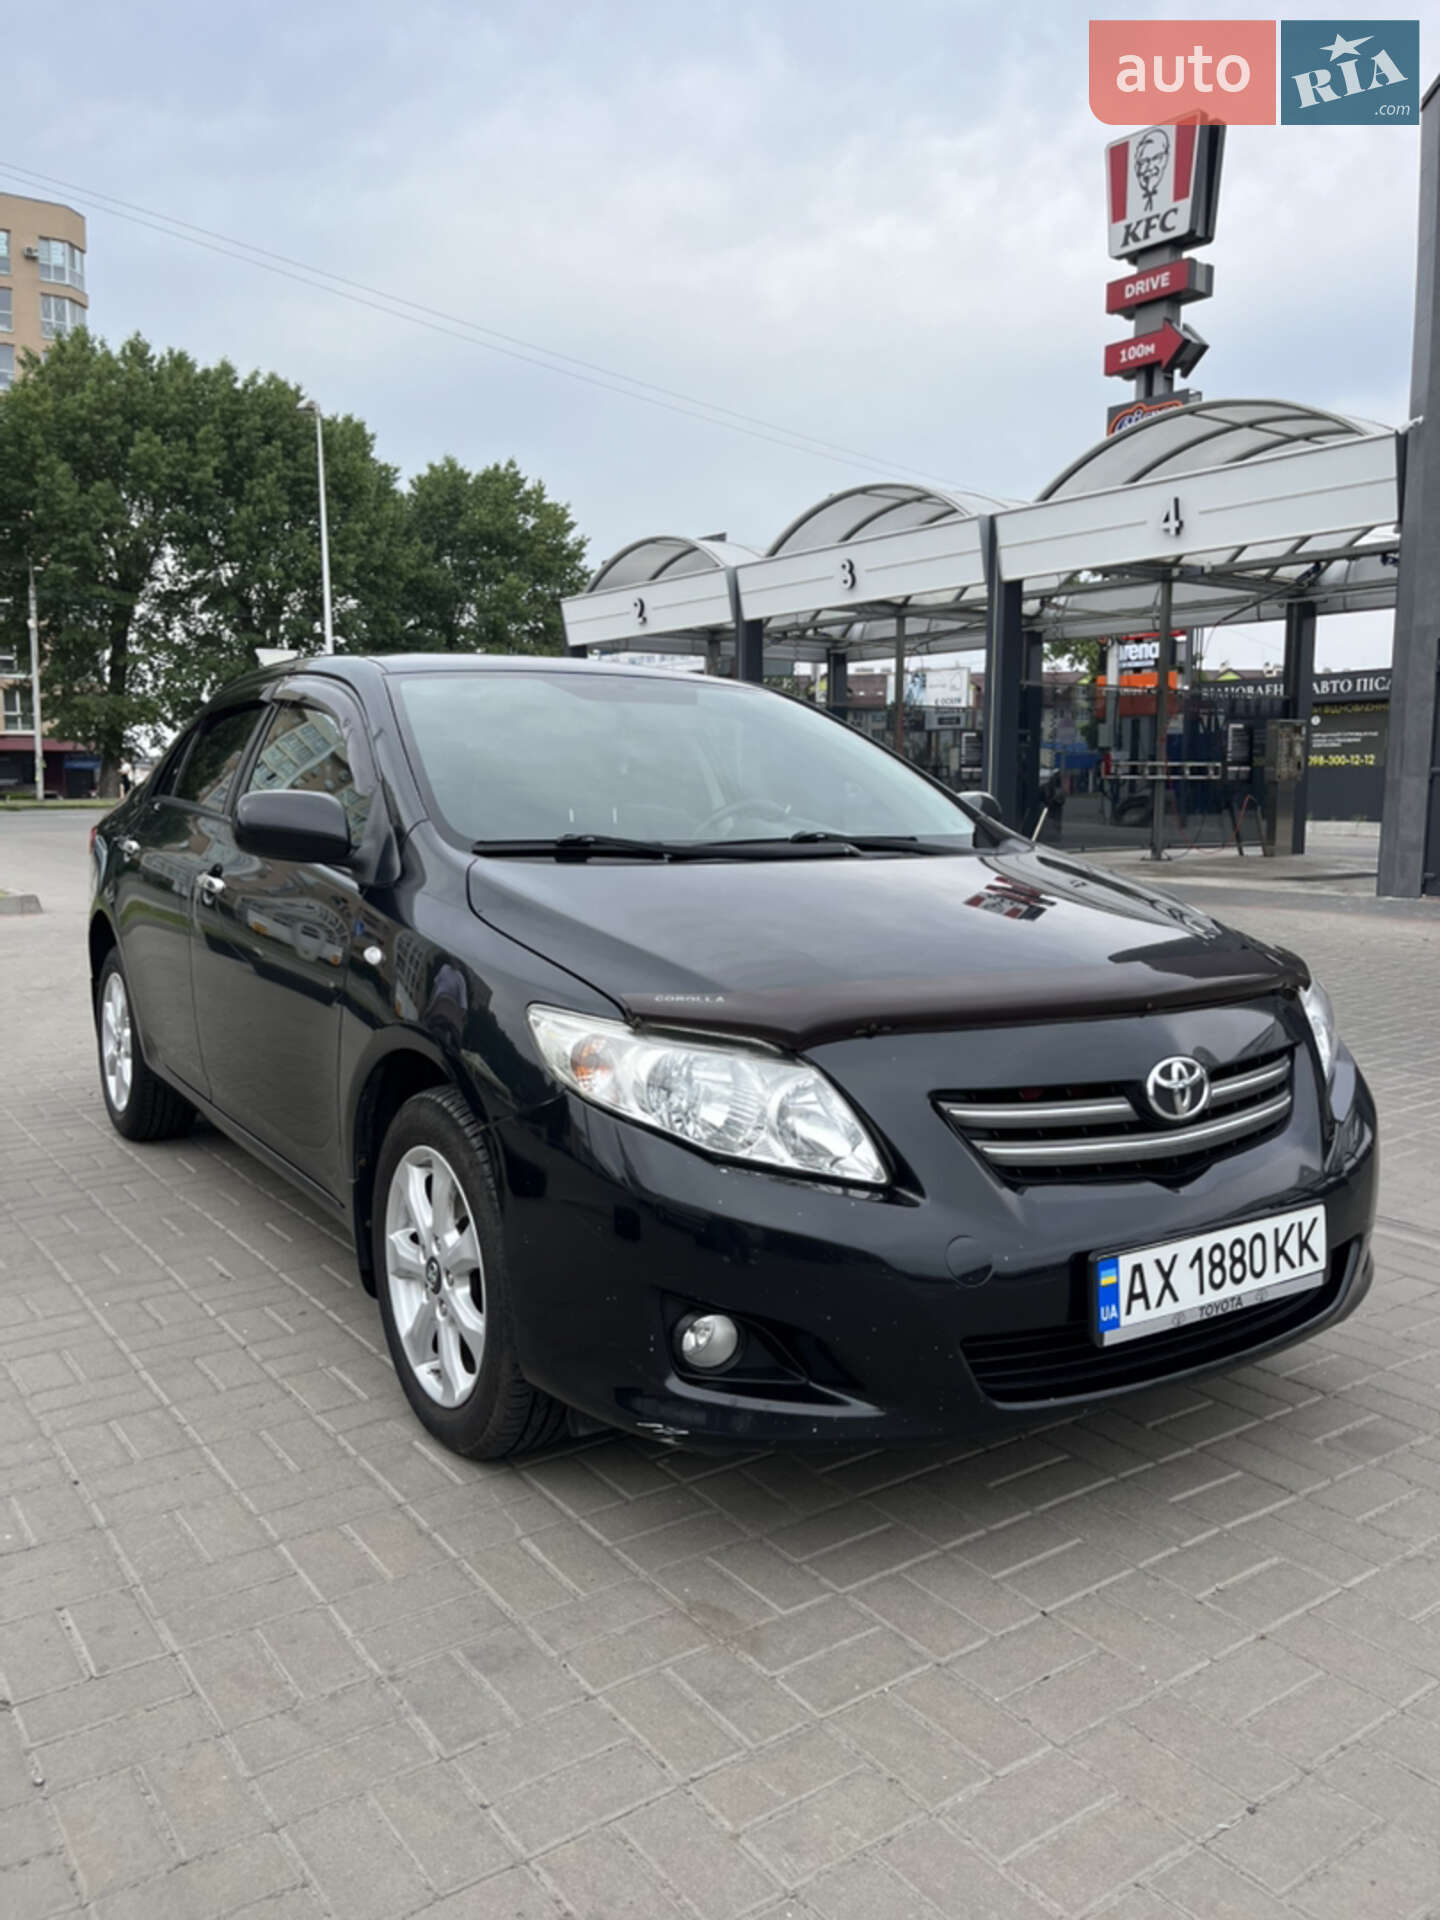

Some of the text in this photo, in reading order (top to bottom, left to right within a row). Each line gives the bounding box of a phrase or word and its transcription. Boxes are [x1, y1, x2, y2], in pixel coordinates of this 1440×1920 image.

[1120, 207, 1179, 248] KFC
[1124, 272, 1171, 299] DRIVE
[1162, 497, 1183, 536] 4
[840, 558, 857, 590] 3
[633, 598, 648, 625] 2
[1125, 1216, 1320, 1316] AX 1880 KK
[1100, 1303, 1119, 1321] UA
[1199, 1296, 1245, 1317] TOYOTA
